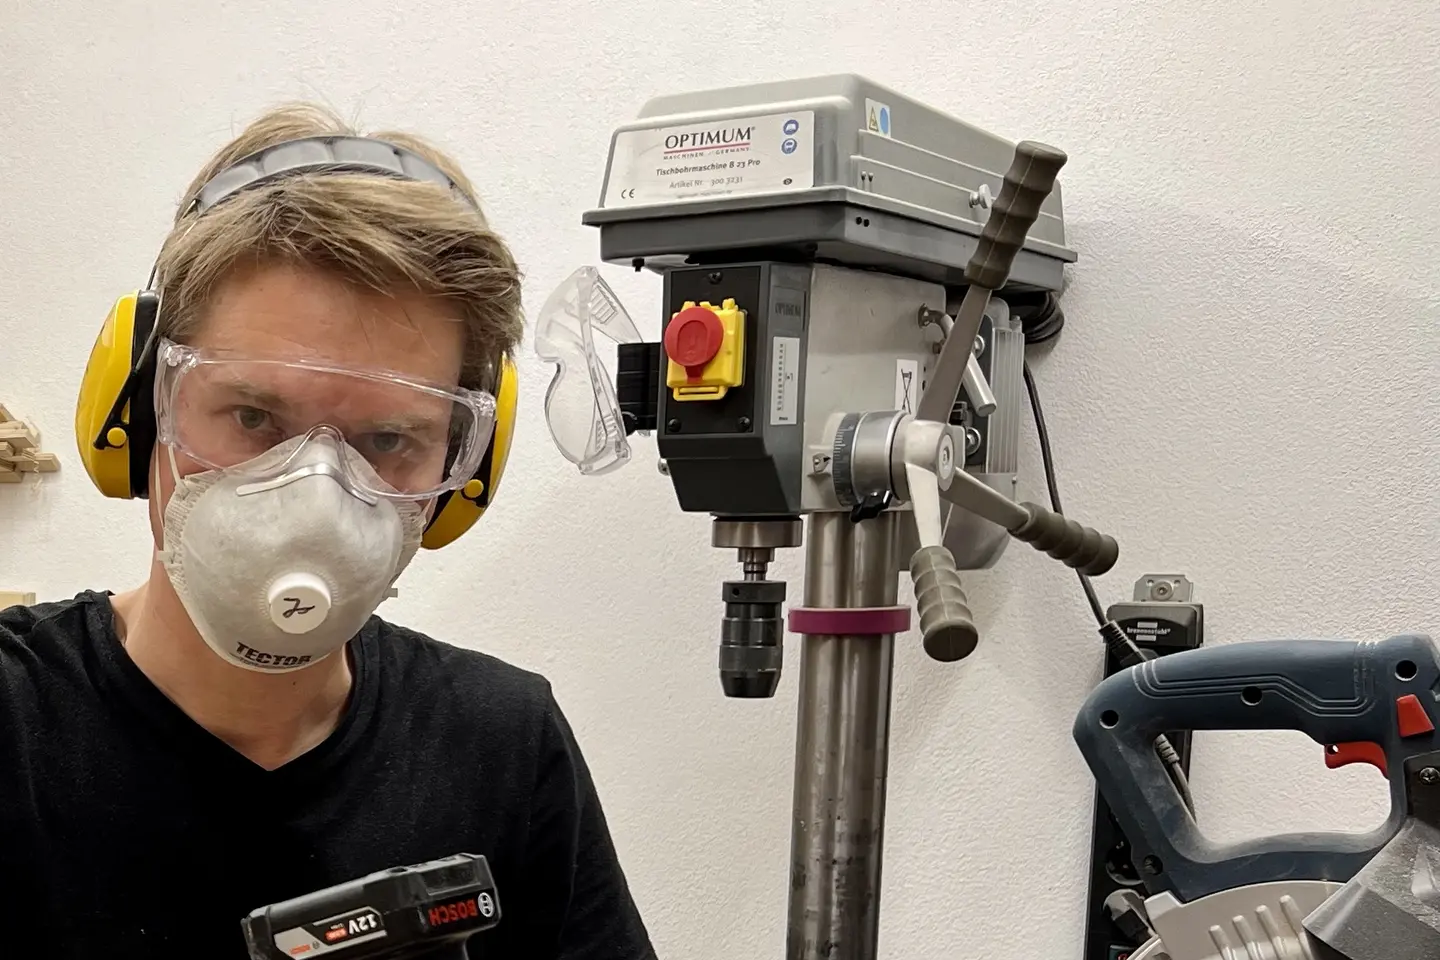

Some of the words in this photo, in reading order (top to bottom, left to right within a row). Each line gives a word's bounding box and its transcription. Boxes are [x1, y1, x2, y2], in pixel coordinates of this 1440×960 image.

[665, 126, 751, 149] OPTIMUM
[656, 163, 728, 176] Tischbohrmaschine
[748, 159, 761, 167] Pro
[236, 641, 313, 666] TECTOR
[348, 913, 378, 935] 12V
[428, 898, 478, 927] BOSCH
